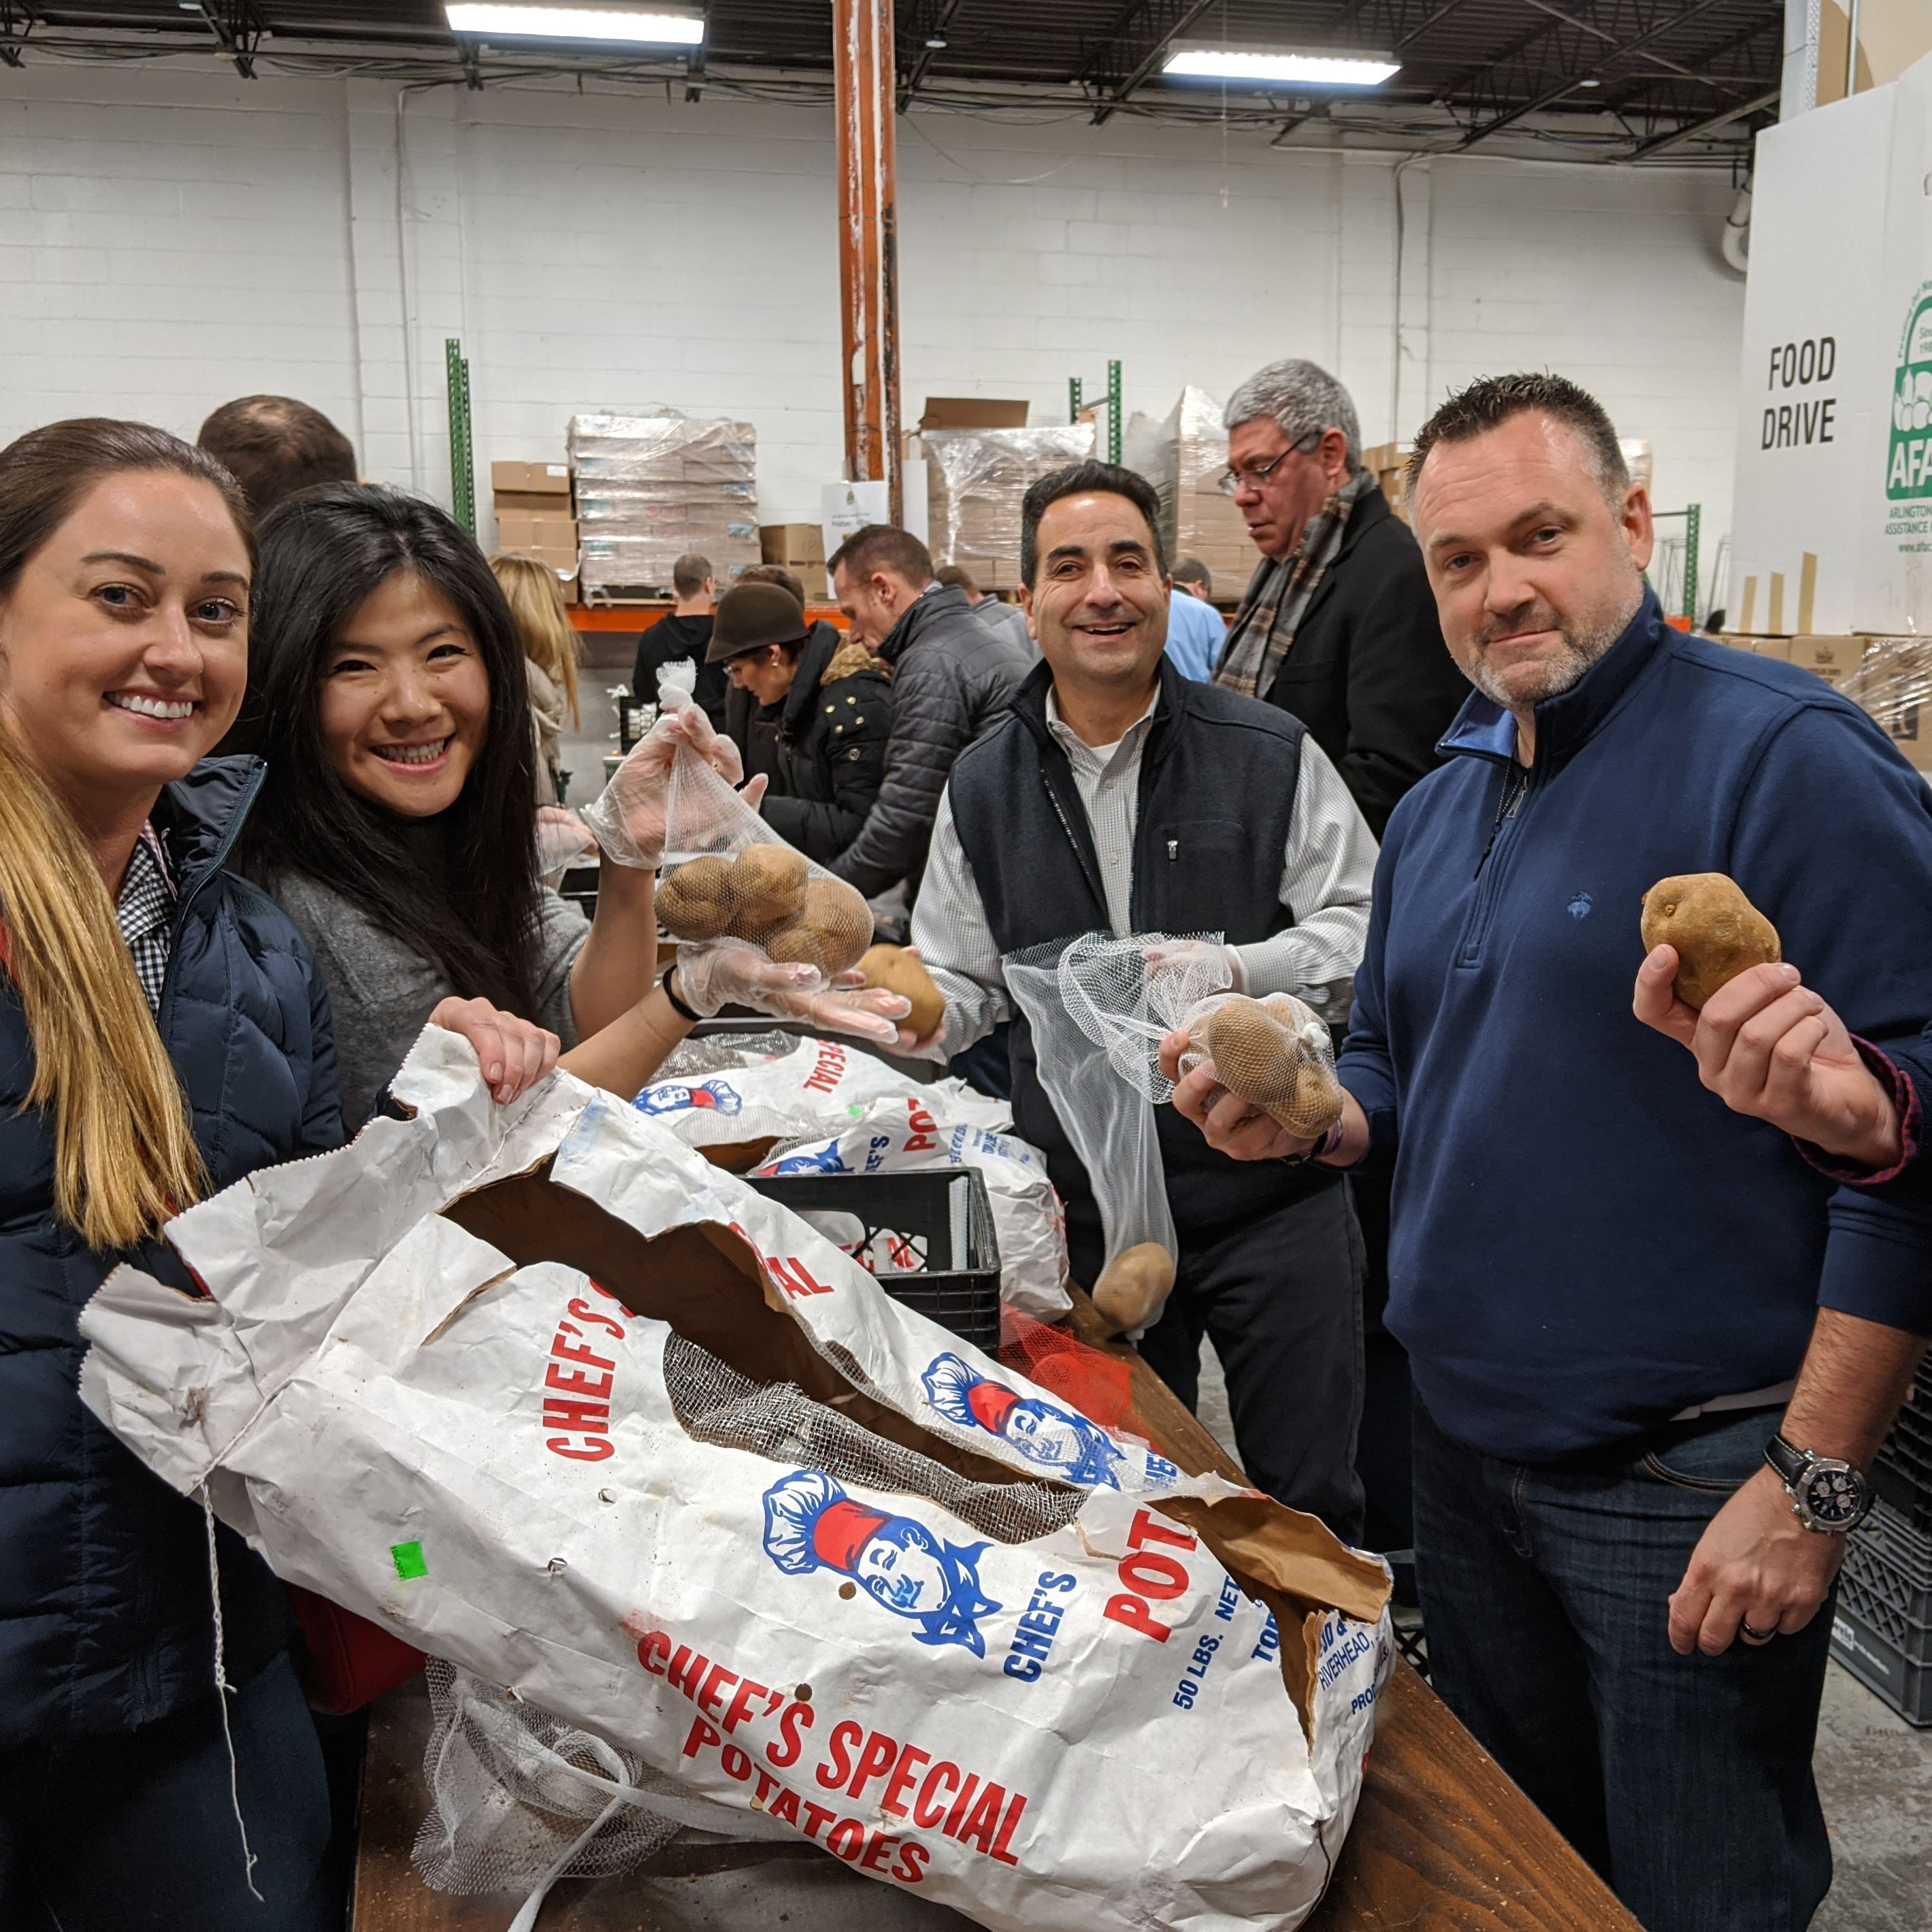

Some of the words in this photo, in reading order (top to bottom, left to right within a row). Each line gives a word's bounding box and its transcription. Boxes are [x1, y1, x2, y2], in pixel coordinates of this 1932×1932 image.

[1769, 337, 1835, 391] FOOD
[1761, 399, 1837, 451] DRIVE
[1884, 521, 1929, 535] ASSISTANCE
[1888, 505, 1932, 519] ARLINGTON
[542, 1298, 625, 1461] CHEF'S
[1003, 1571, 1077, 1682] CHEF'S
[1172, 1678, 1200, 1710] 50
[1187, 1634, 1224, 1679] LBS.
[1215, 1575, 1243, 1622] NET
[1318, 1631, 1375, 1691] RIVERHEAD,
[636, 1631, 815, 1767] CHEF'S
[816, 1720, 1028, 1866] SPECIAL
[682, 1715, 930, 1882] POTATOES
